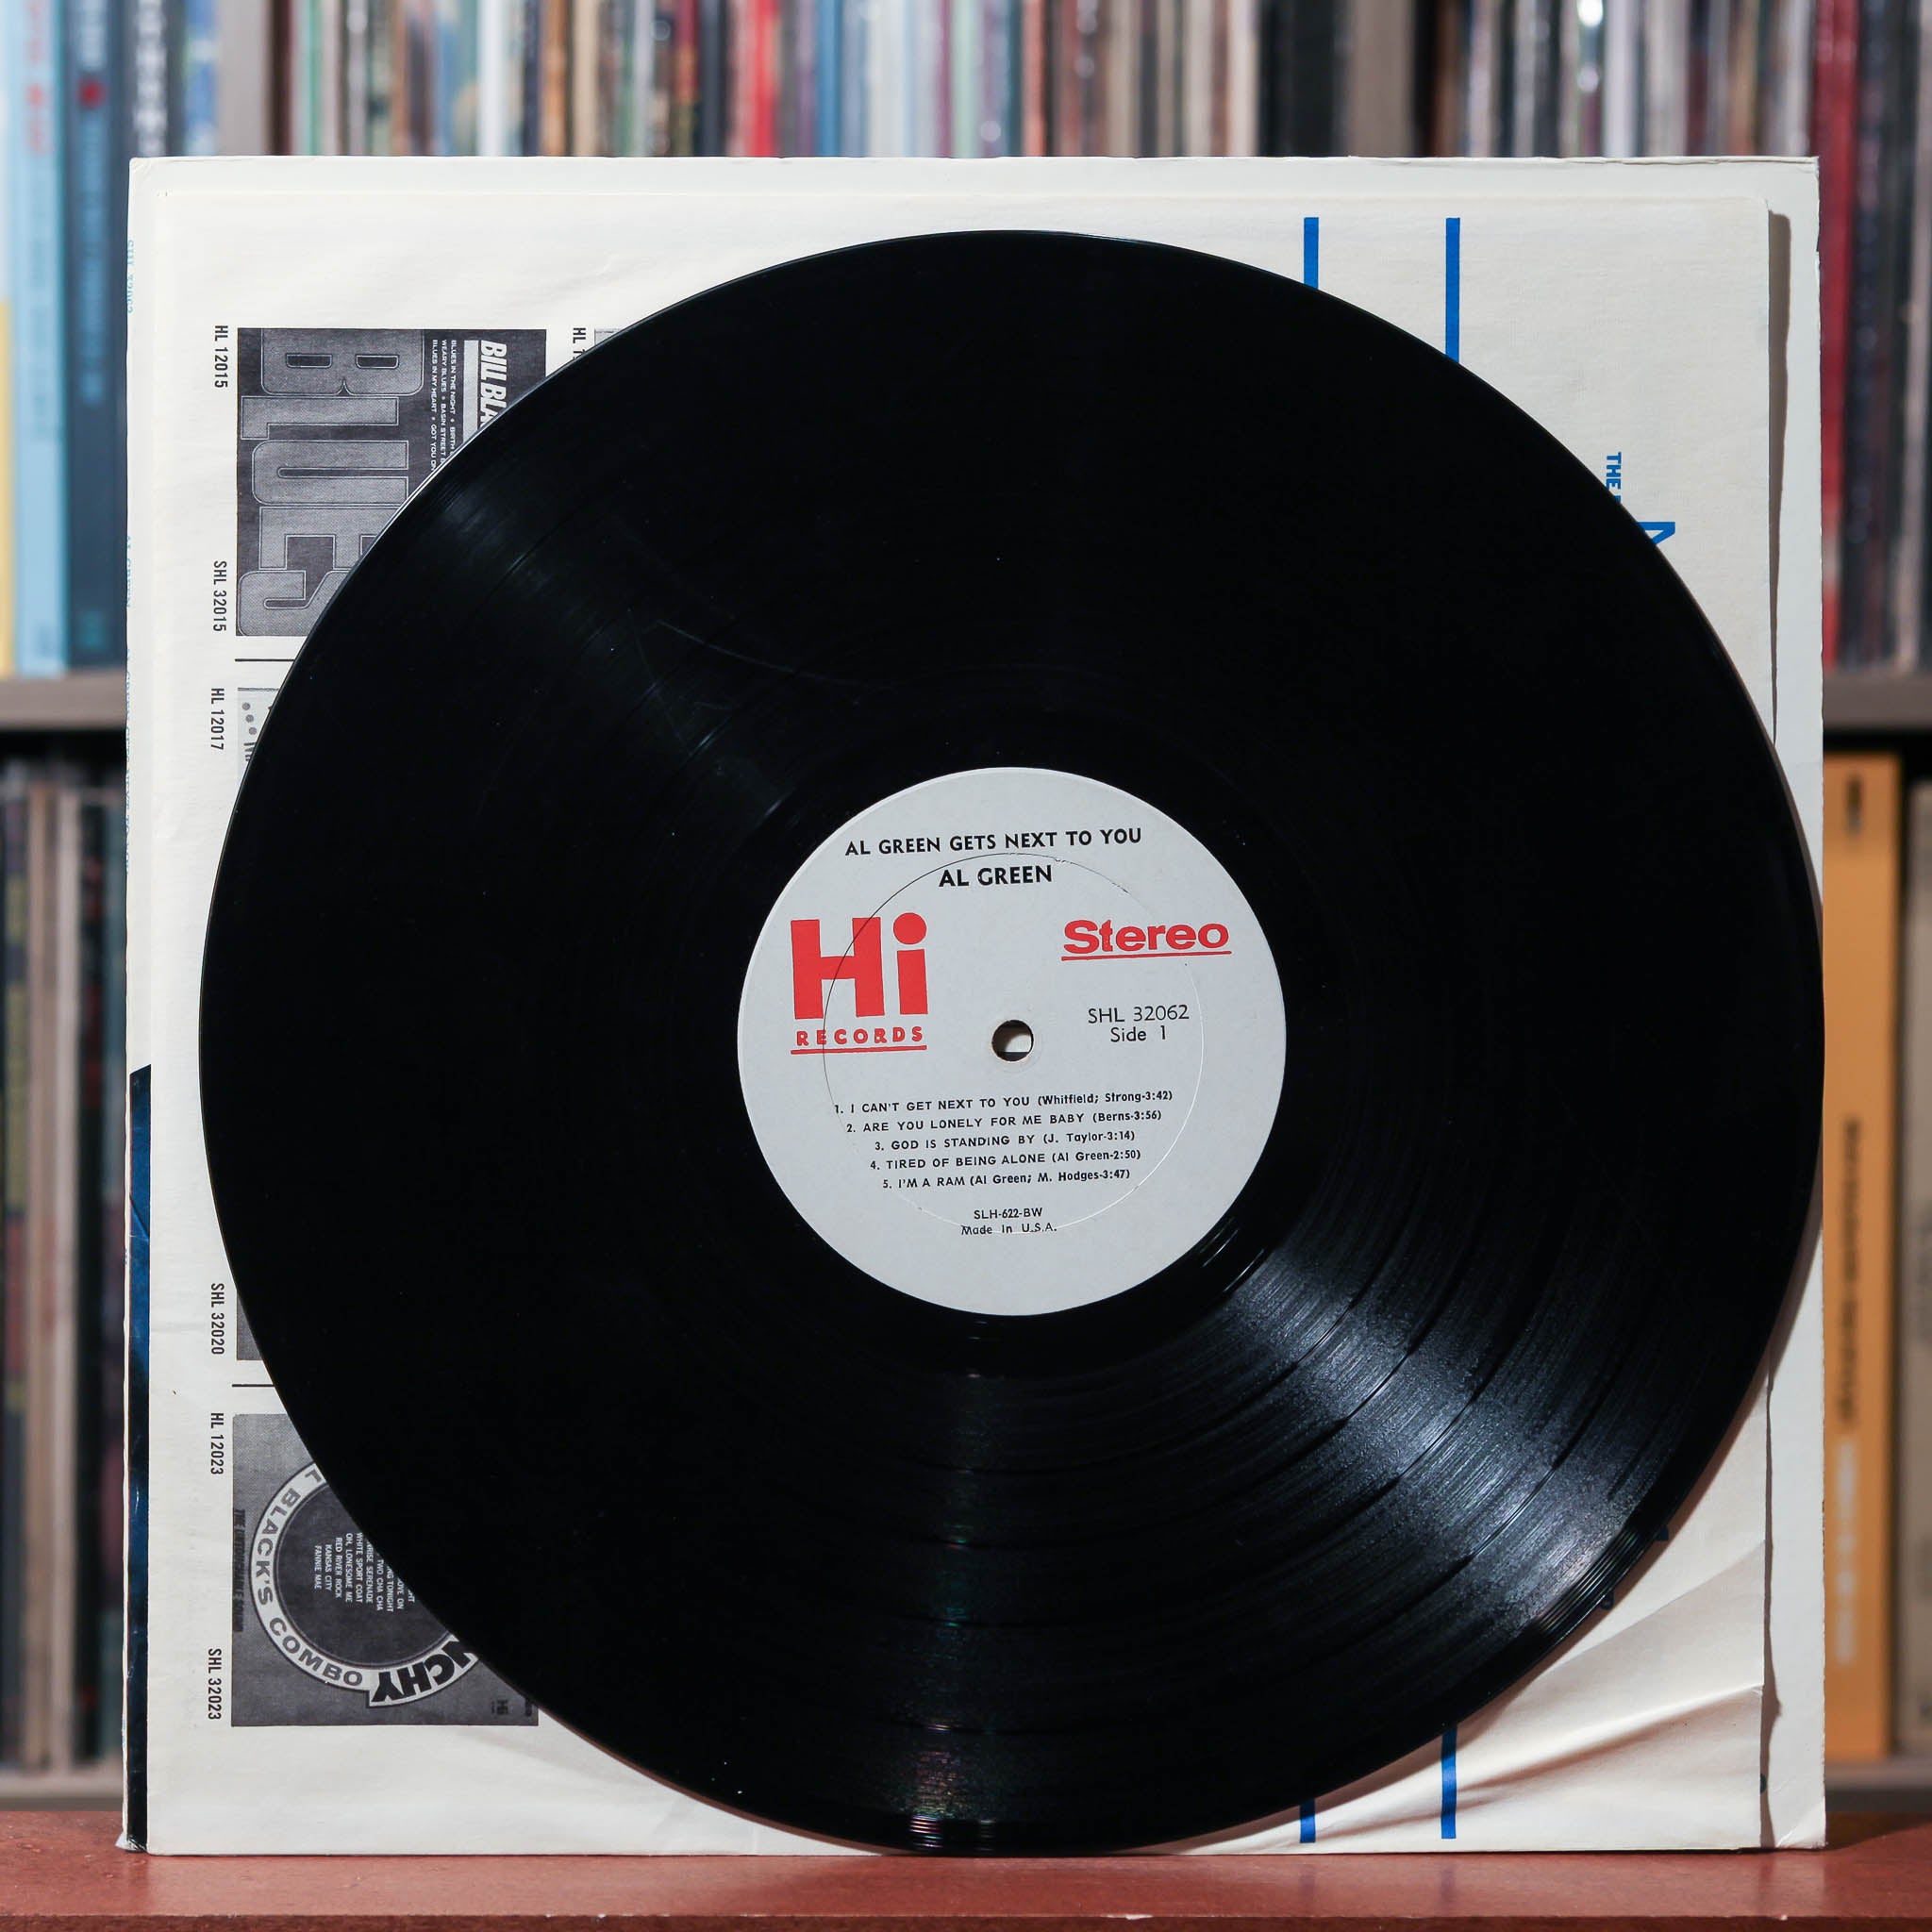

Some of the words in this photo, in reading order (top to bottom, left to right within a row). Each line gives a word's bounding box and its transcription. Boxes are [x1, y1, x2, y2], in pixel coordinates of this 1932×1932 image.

[214, 325, 228, 341] HL
[573, 327, 586, 343] HL
[214, 346, 228, 389] 12015
[432, 365, 438, 374] IN
[450, 365, 456, 374] IN
[480, 340, 507, 380] BILL
[431, 375, 437, 386] MY
[480, 382, 507, 431] BLA
[1606, 452, 1622, 490] THE
[213, 560, 226, 585] SHL
[213, 590, 226, 632] 32015
[211, 688, 225, 705] HL
[210, 709, 225, 750] 12017
[845, 836, 871, 857] AL
[878, 833, 941, 855] GREEN
[949, 833, 995, 852] GETS
[1005, 831, 1058, 849] NEXT
[1065, 828, 1092, 846] TO
[1099, 827, 1142, 844] YOU
[938, 869, 970, 888] AL
[976, 864, 1053, 886] GREEN
[1064, 919, 1229, 955] Stereo
[790, 912, 929, 1020] Hi
[1088, 1007, 1124, 1024] SHL
[1133, 1004, 1190, 1022] 32062
[795, 1026, 924, 1046] RECORDS
[1110, 1026, 1147, 1042] Side
[1160, 1025, 1167, 1041] 1
[835, 1105, 843, 1113] 1.
[861, 1102, 899, 1112] CAN'T
[907, 1102, 932, 1111] GET
[939, 1100, 973, 1110] NEXT
[980, 1099, 995, 1108] TO
[1004, 1097, 1029, 1107] YOU
[1038, 1093, 1098, 1106] (Whitfield;
[1105, 1091, 1173, 1103] Strong-3:42)
[847, 1124, 856, 1132] 2.
[863, 1123, 889, 1132] ARE
[898, 1121, 924, 1130] YOU
[931, 1118, 982, 1129] LONELY
[991, 1117, 1016, 1125] FOR
[1023, 1115, 1041, 1124] ME
[1050, 1114, 1084, 1124] BABY
[1093, 1110, 1161, 1123] (Berns-3:56)
[891, 1141, 919, 1149] GOD
[925, 1140, 936, 1148] IS
[944, 1136, 1009, 1147] STANDING
[1019, 1135, 1034, 1144] BY
[1043, 1134, 1058, 1144] (J.
[1067, 1131, 1135, 1143] Taylor-3:14)
[871, 1161, 880, 1170] 4.
[887, 1159, 925, 1169] TIRED
[933, 1158, 949, 1167] OF
[956, 1156, 996, 1166] BEING
[1002, 1154, 1045, 1164] ALONE
[1075, 1150, 1141, 1161] Green-2:50)
[898, 1178, 917, 1188] I'M
[923, 1178, 930, 1187] A
[937, 1176, 965, 1187] RAM
[992, 1174, 1032, 1184] Green;
[1038, 1173, 1052, 1182] M.
[1058, 1170, 1130, 1181] Hodges-3:47)
[974, 1208, 1042, 1219] SLH-622-BW
[961, 1225, 992, 1235] Made
[1022, 1223, 1057, 1232] U.S.A.
[211, 1283, 225, 1307] SHL
[211, 1312, 225, 1355] 32020
[211, 1412, 224, 1429] HL
[211, 1434, 224, 1474] 12023
[256, 1487, 302, 1606] BLACK'S
[345, 1591, 352, 1602] ME
[397, 1598, 404, 1609] ON
[208, 1648, 222, 1674] SHL
[268, 1617, 364, 1686] COMBO
[208, 1678, 222, 1720] 32023
